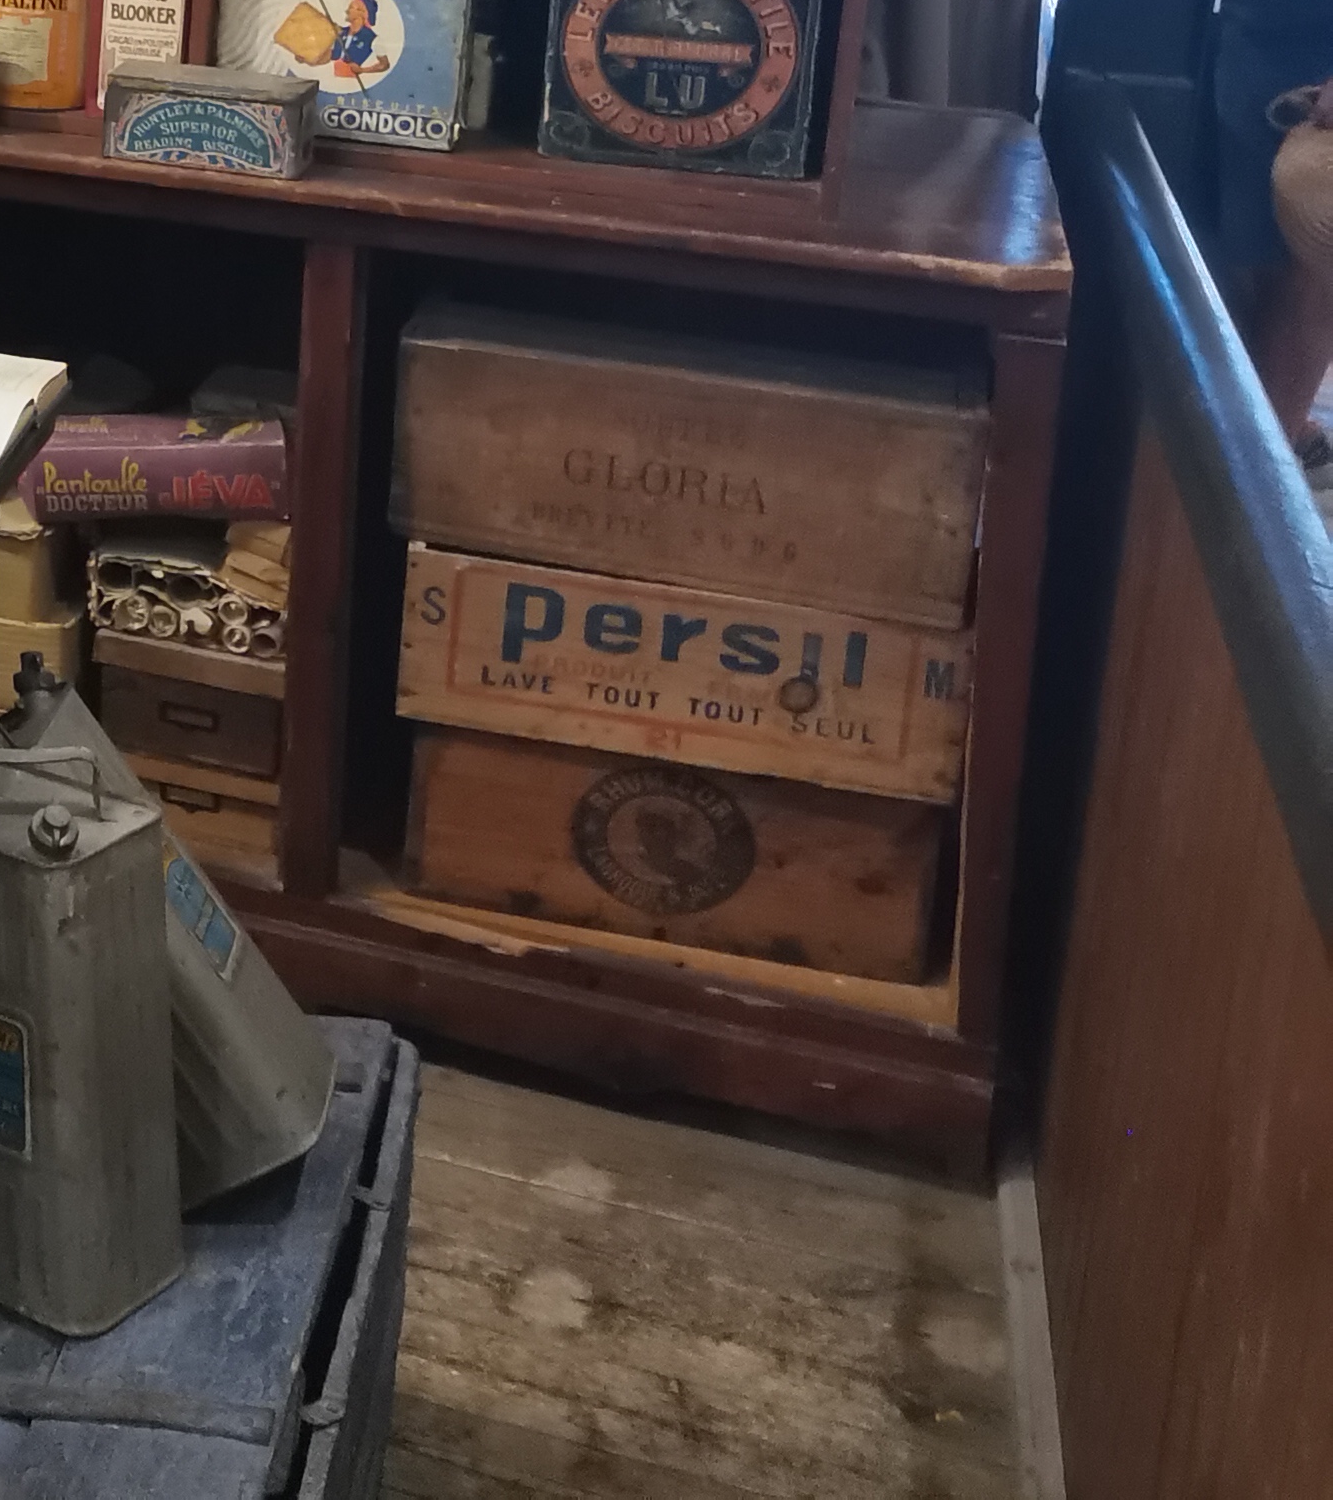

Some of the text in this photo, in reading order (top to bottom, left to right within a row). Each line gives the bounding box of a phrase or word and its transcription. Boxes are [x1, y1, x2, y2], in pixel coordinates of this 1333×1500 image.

[110, 2, 177, 26] BLOOKER
[645, 71, 705, 108] LU
[133, 104, 191, 138] HUNTLEY
[159, 123, 237, 141] SUPERIOR
[323, 110, 448, 141] GONDOLO
[133, 137, 193, 151] READING
[563, 446, 768, 515] GLORIA
[45, 493, 149, 514] DOCTEUR
[419, 584, 448, 626] S
[502, 581, 869, 690] persil
[480, 664, 876, 746] LAVE TOUT TOUT SEUL
